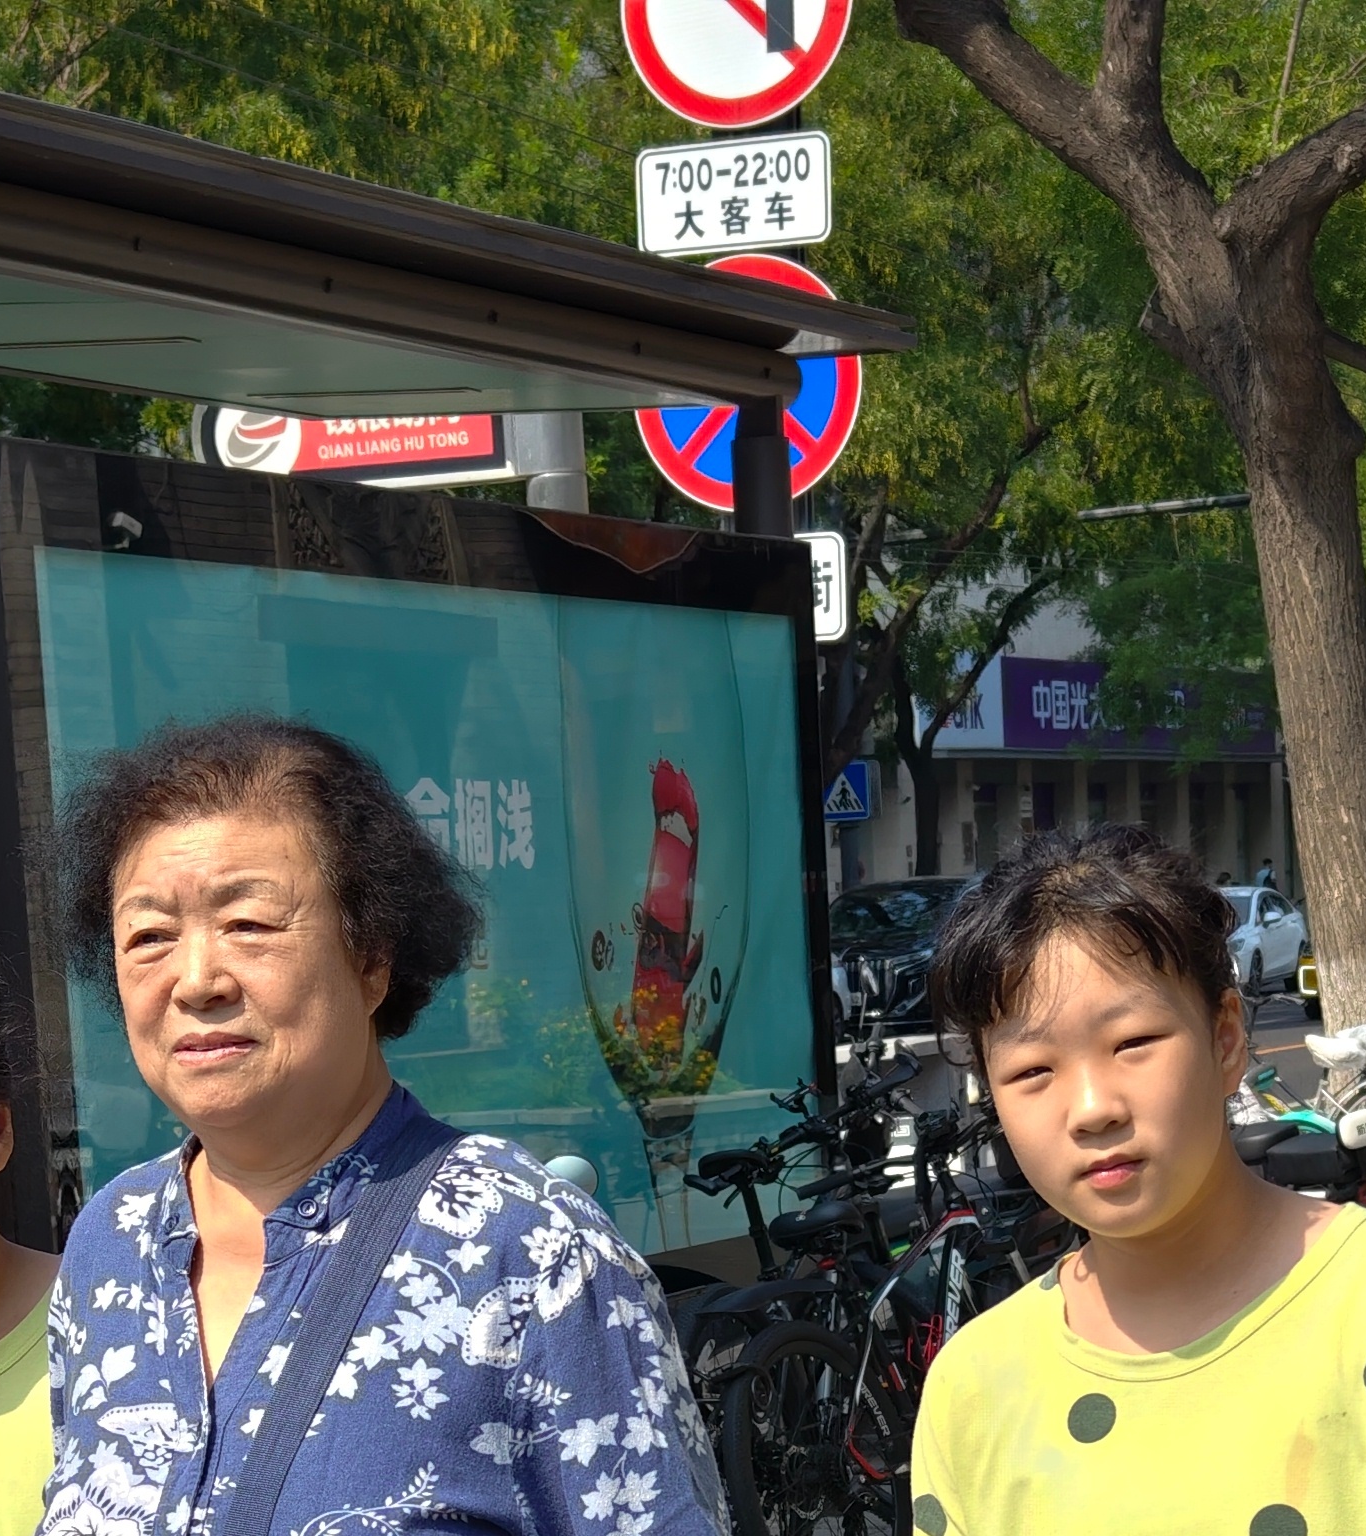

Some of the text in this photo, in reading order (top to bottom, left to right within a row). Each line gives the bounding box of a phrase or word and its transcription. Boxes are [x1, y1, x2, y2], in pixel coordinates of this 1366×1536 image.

[655, 148, 811, 196] 7:00-22:00
[674, 191, 796, 240] 大客车
[318, 431, 469, 459] QIAN LIANG HU TONG
[944, 1248, 967, 1343] REVER
